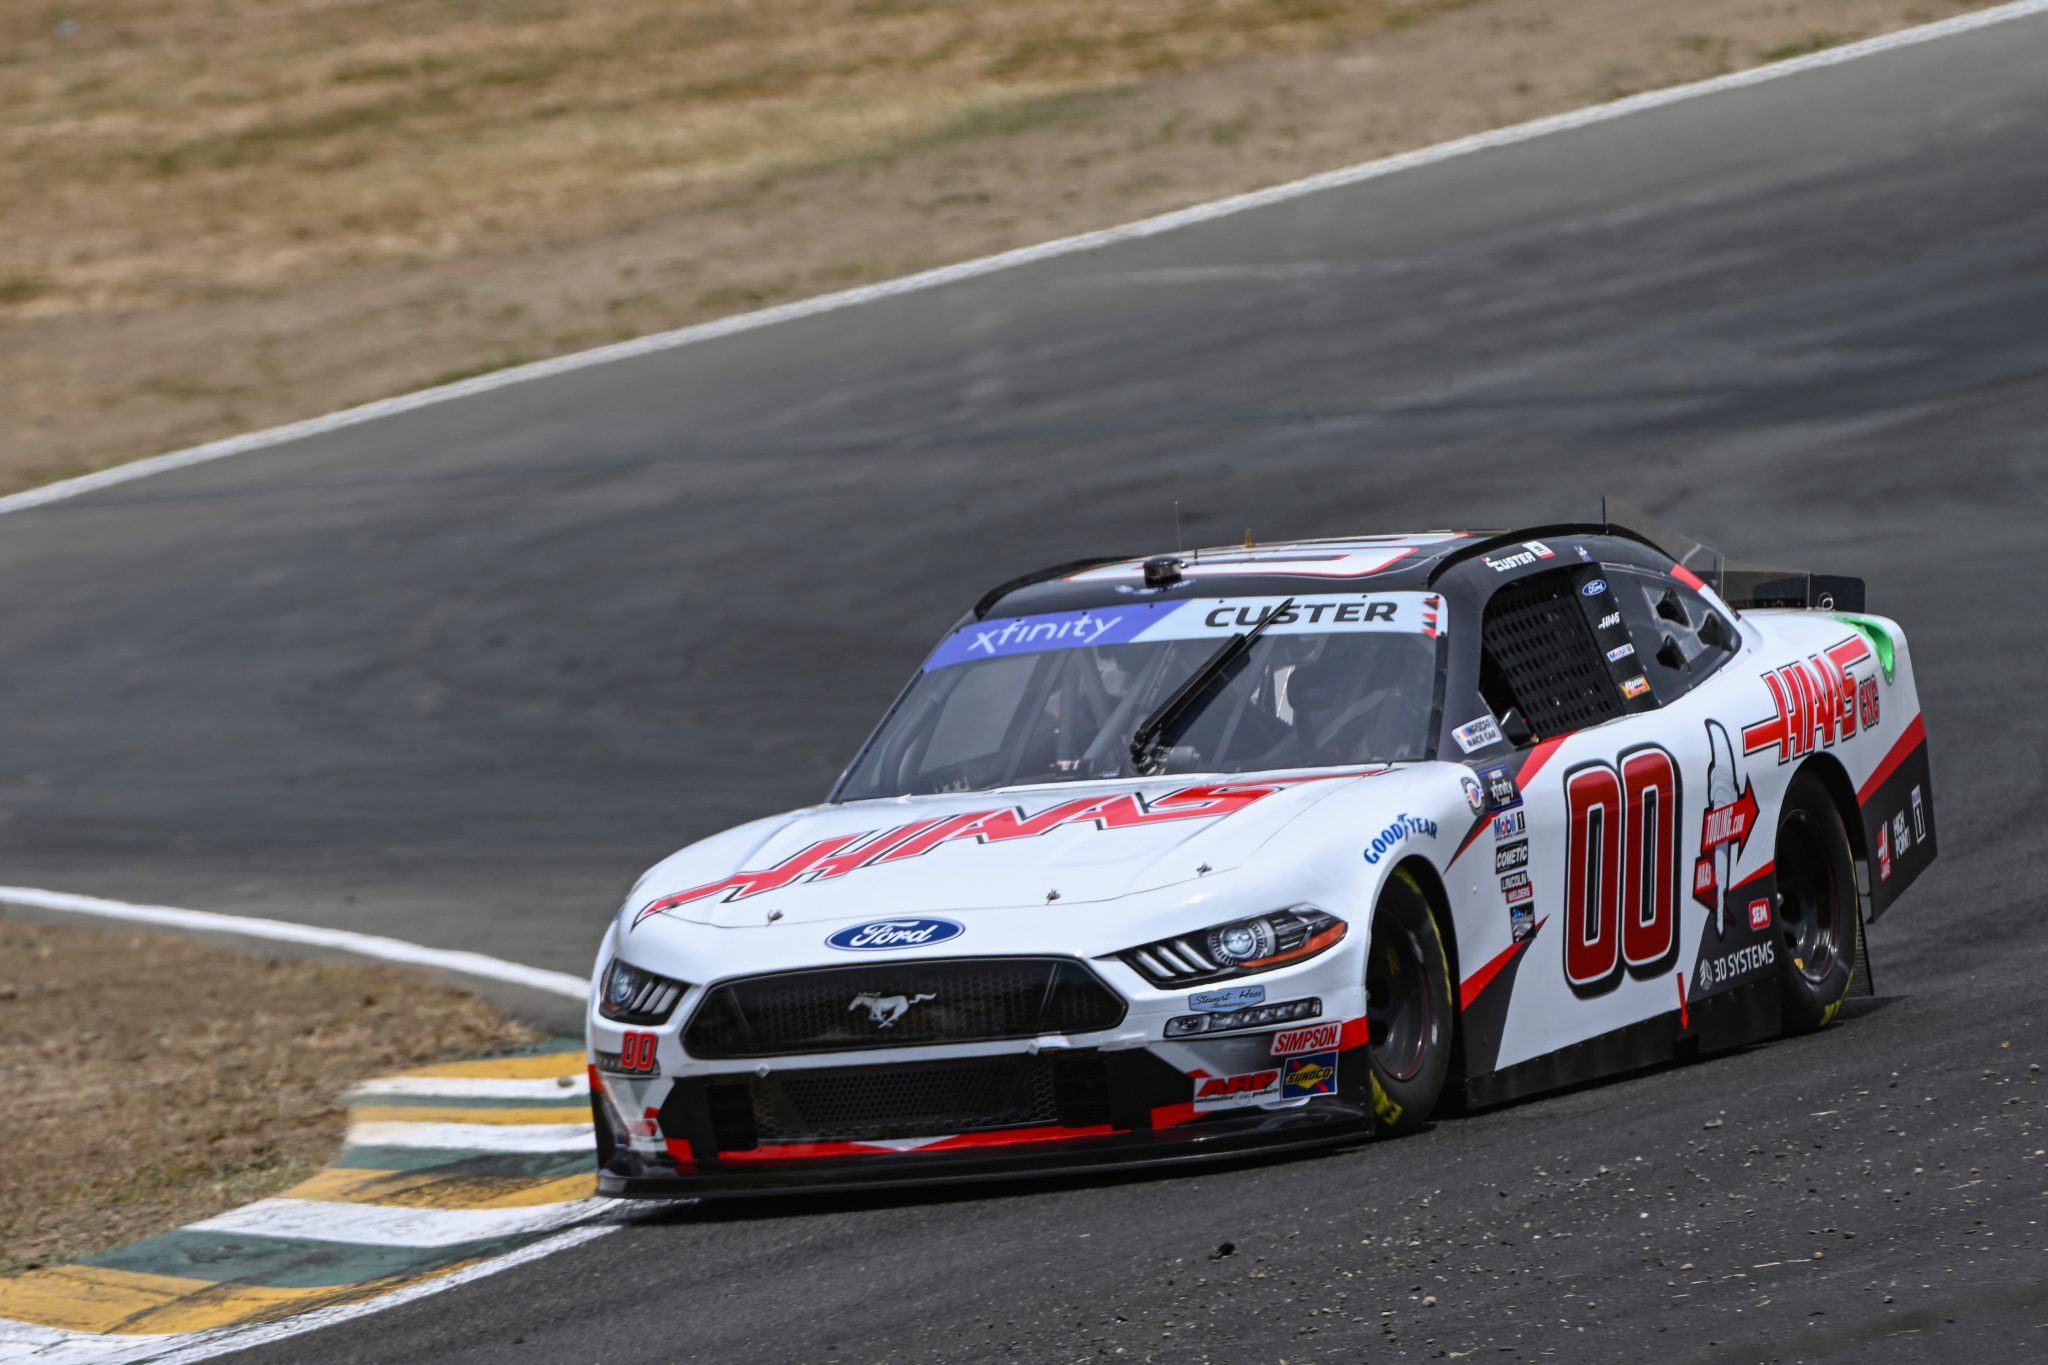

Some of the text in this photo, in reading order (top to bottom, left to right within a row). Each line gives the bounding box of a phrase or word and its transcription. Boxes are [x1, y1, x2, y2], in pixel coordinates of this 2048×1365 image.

[1492, 551, 1537, 572] CUSTER
[967, 602, 1398, 654] xfinity CUSTER
[1741, 634, 1871, 766] HAAS
[1494, 813, 1516, 837] Mobil
[1363, 813, 1437, 865] GOODYEAR
[631, 784, 1284, 931] HAAS
[1496, 845, 1528, 868] COMETIC
[1502, 872, 1527, 890] LINCOLN
[1563, 742, 1683, 1000] 00
[1752, 903, 1768, 924] SEM
[849, 920, 940, 947] Ford
[1714, 956, 1727, 982] 3D
[1728, 941, 1775, 978] SYSTEMS
[621, 1030, 658, 1071] 00
[1275, 1025, 1338, 1053] SIMPSON
[1197, 1071, 1279, 1097] ARP
[1286, 1067, 1334, 1084] SUNOCO
